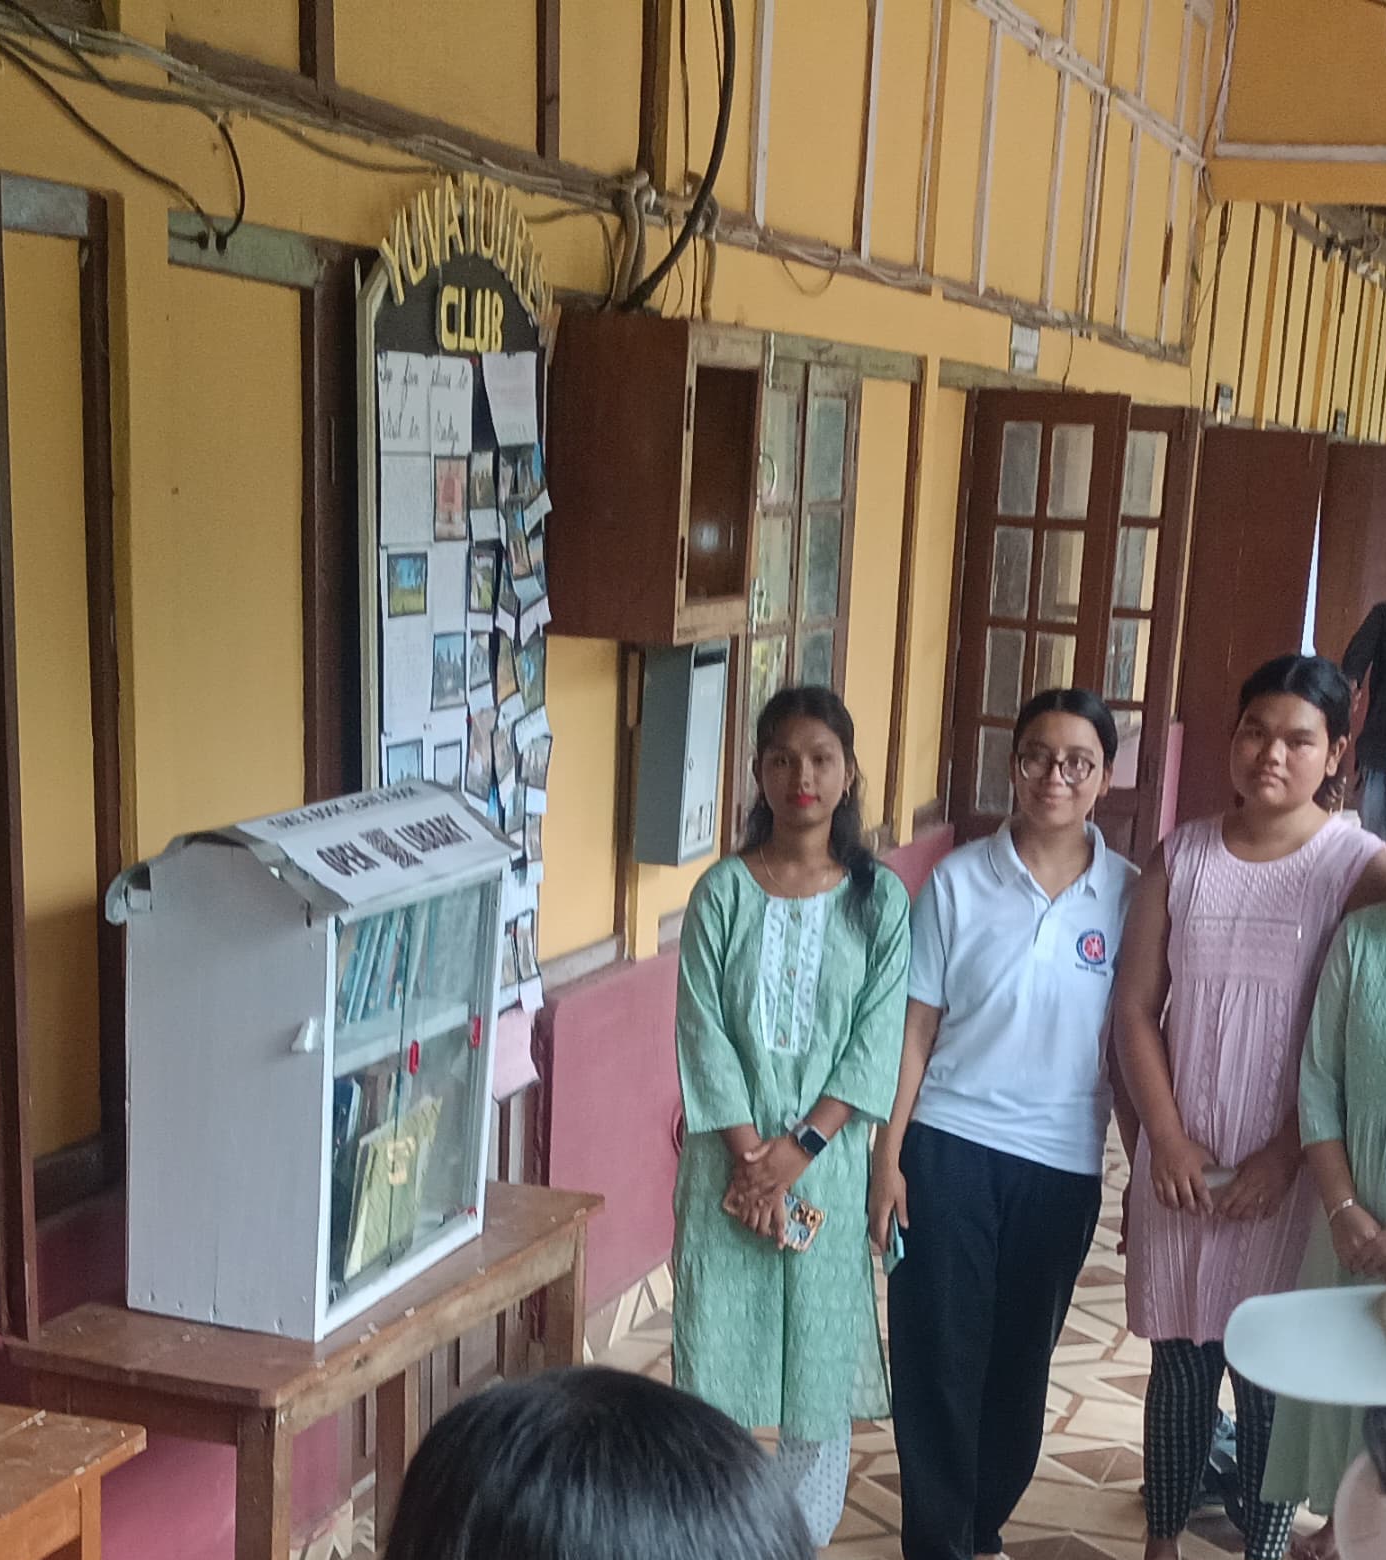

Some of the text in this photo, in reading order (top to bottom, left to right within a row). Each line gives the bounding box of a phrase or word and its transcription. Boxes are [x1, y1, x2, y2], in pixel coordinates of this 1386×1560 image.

[379, 175, 464, 306] YUVA
[440, 284, 505, 353] CLUB
[316, 813, 473, 877] OPEN LIBRARY
